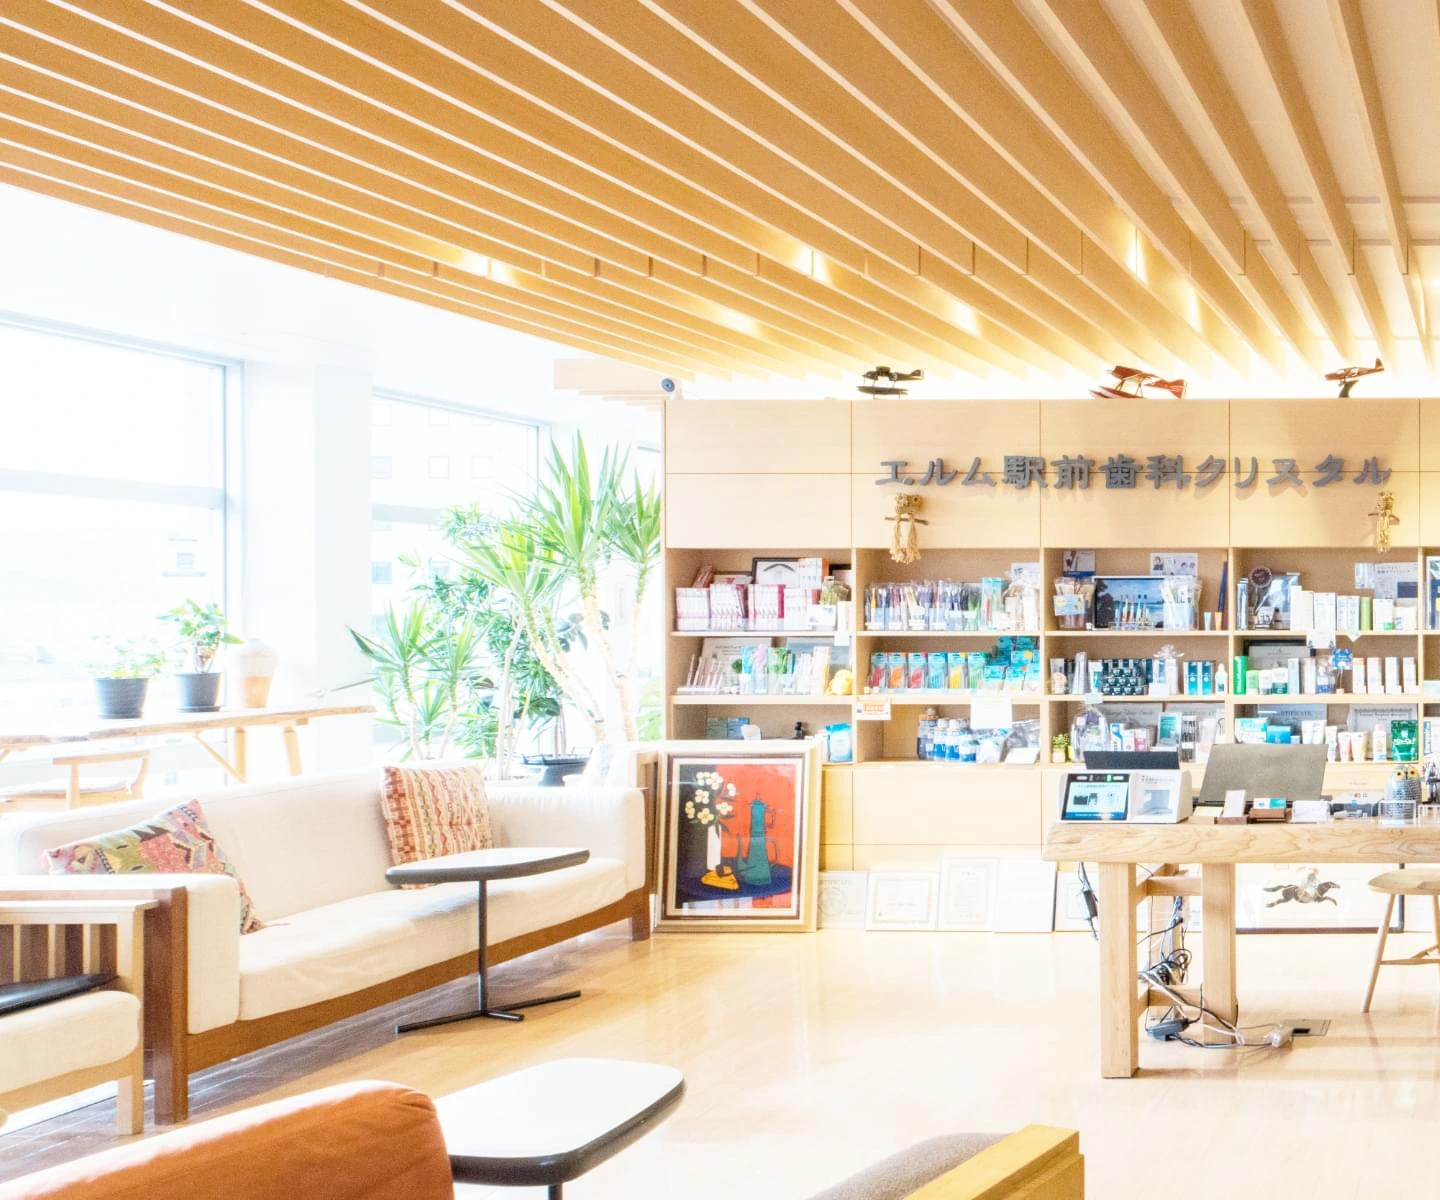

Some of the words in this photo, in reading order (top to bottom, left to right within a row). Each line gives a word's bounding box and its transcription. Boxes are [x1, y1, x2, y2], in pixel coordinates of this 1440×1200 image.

[875, 453, 1395, 490] エルム駅前歯科クリスタル
